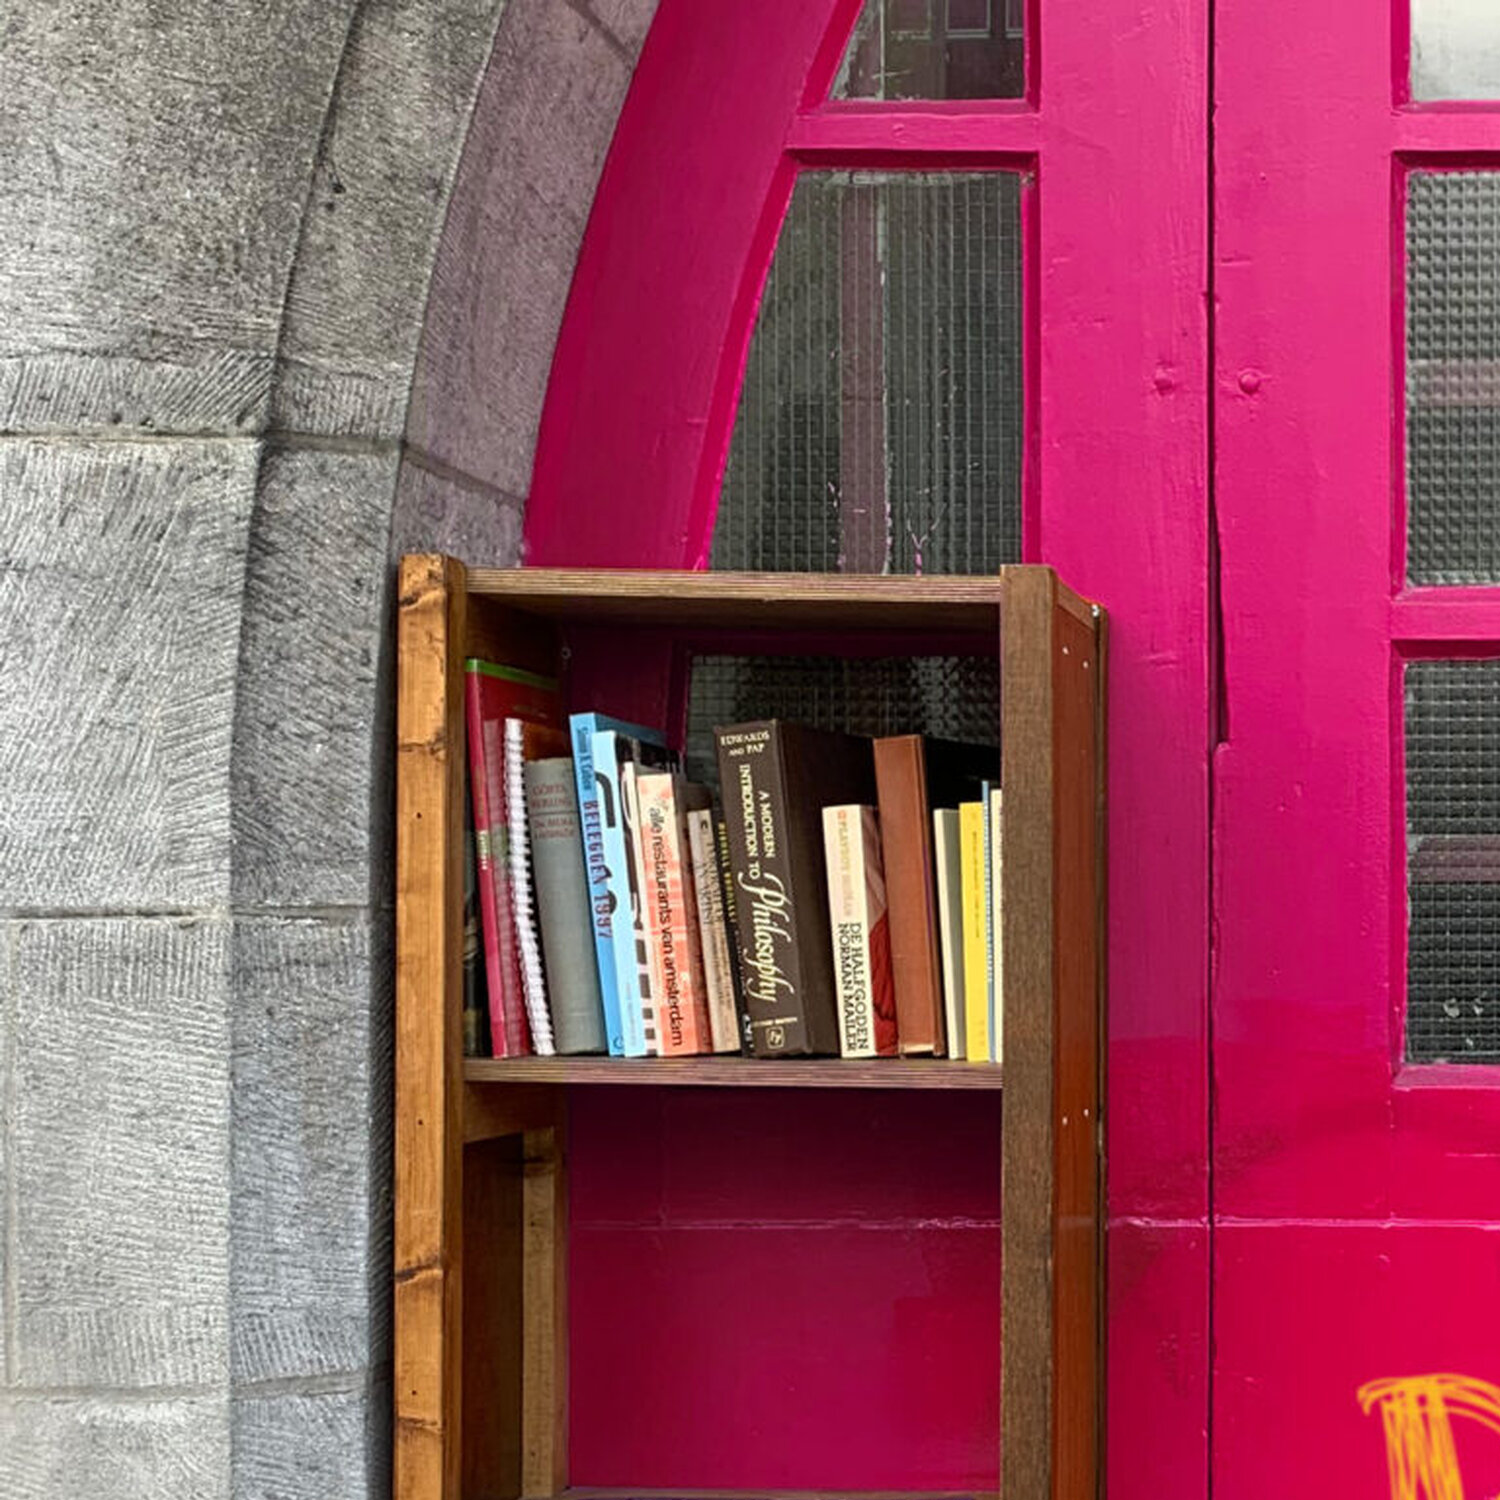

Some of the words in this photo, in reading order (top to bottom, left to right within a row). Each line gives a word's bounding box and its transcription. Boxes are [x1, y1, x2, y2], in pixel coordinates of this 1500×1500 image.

[648, 807, 665, 834] alle
[739, 763, 759, 858] INTRODUCTION
[758, 790, 770, 800] A
[759, 802, 776, 858] MODERN
[652, 835, 673, 925] restaurants
[748, 861, 761, 880] TO
[594, 893, 612, 938] 1997
[660, 925, 673, 954] van
[738, 871, 795, 1002] Philosophy
[849, 922, 862, 945] DE
[838, 922, 853, 991] NORMAN
[663, 956, 684, 1047] amsterdam
[843, 994, 857, 1052] MAILER
[850, 946, 869, 1050] HALFGODEN
